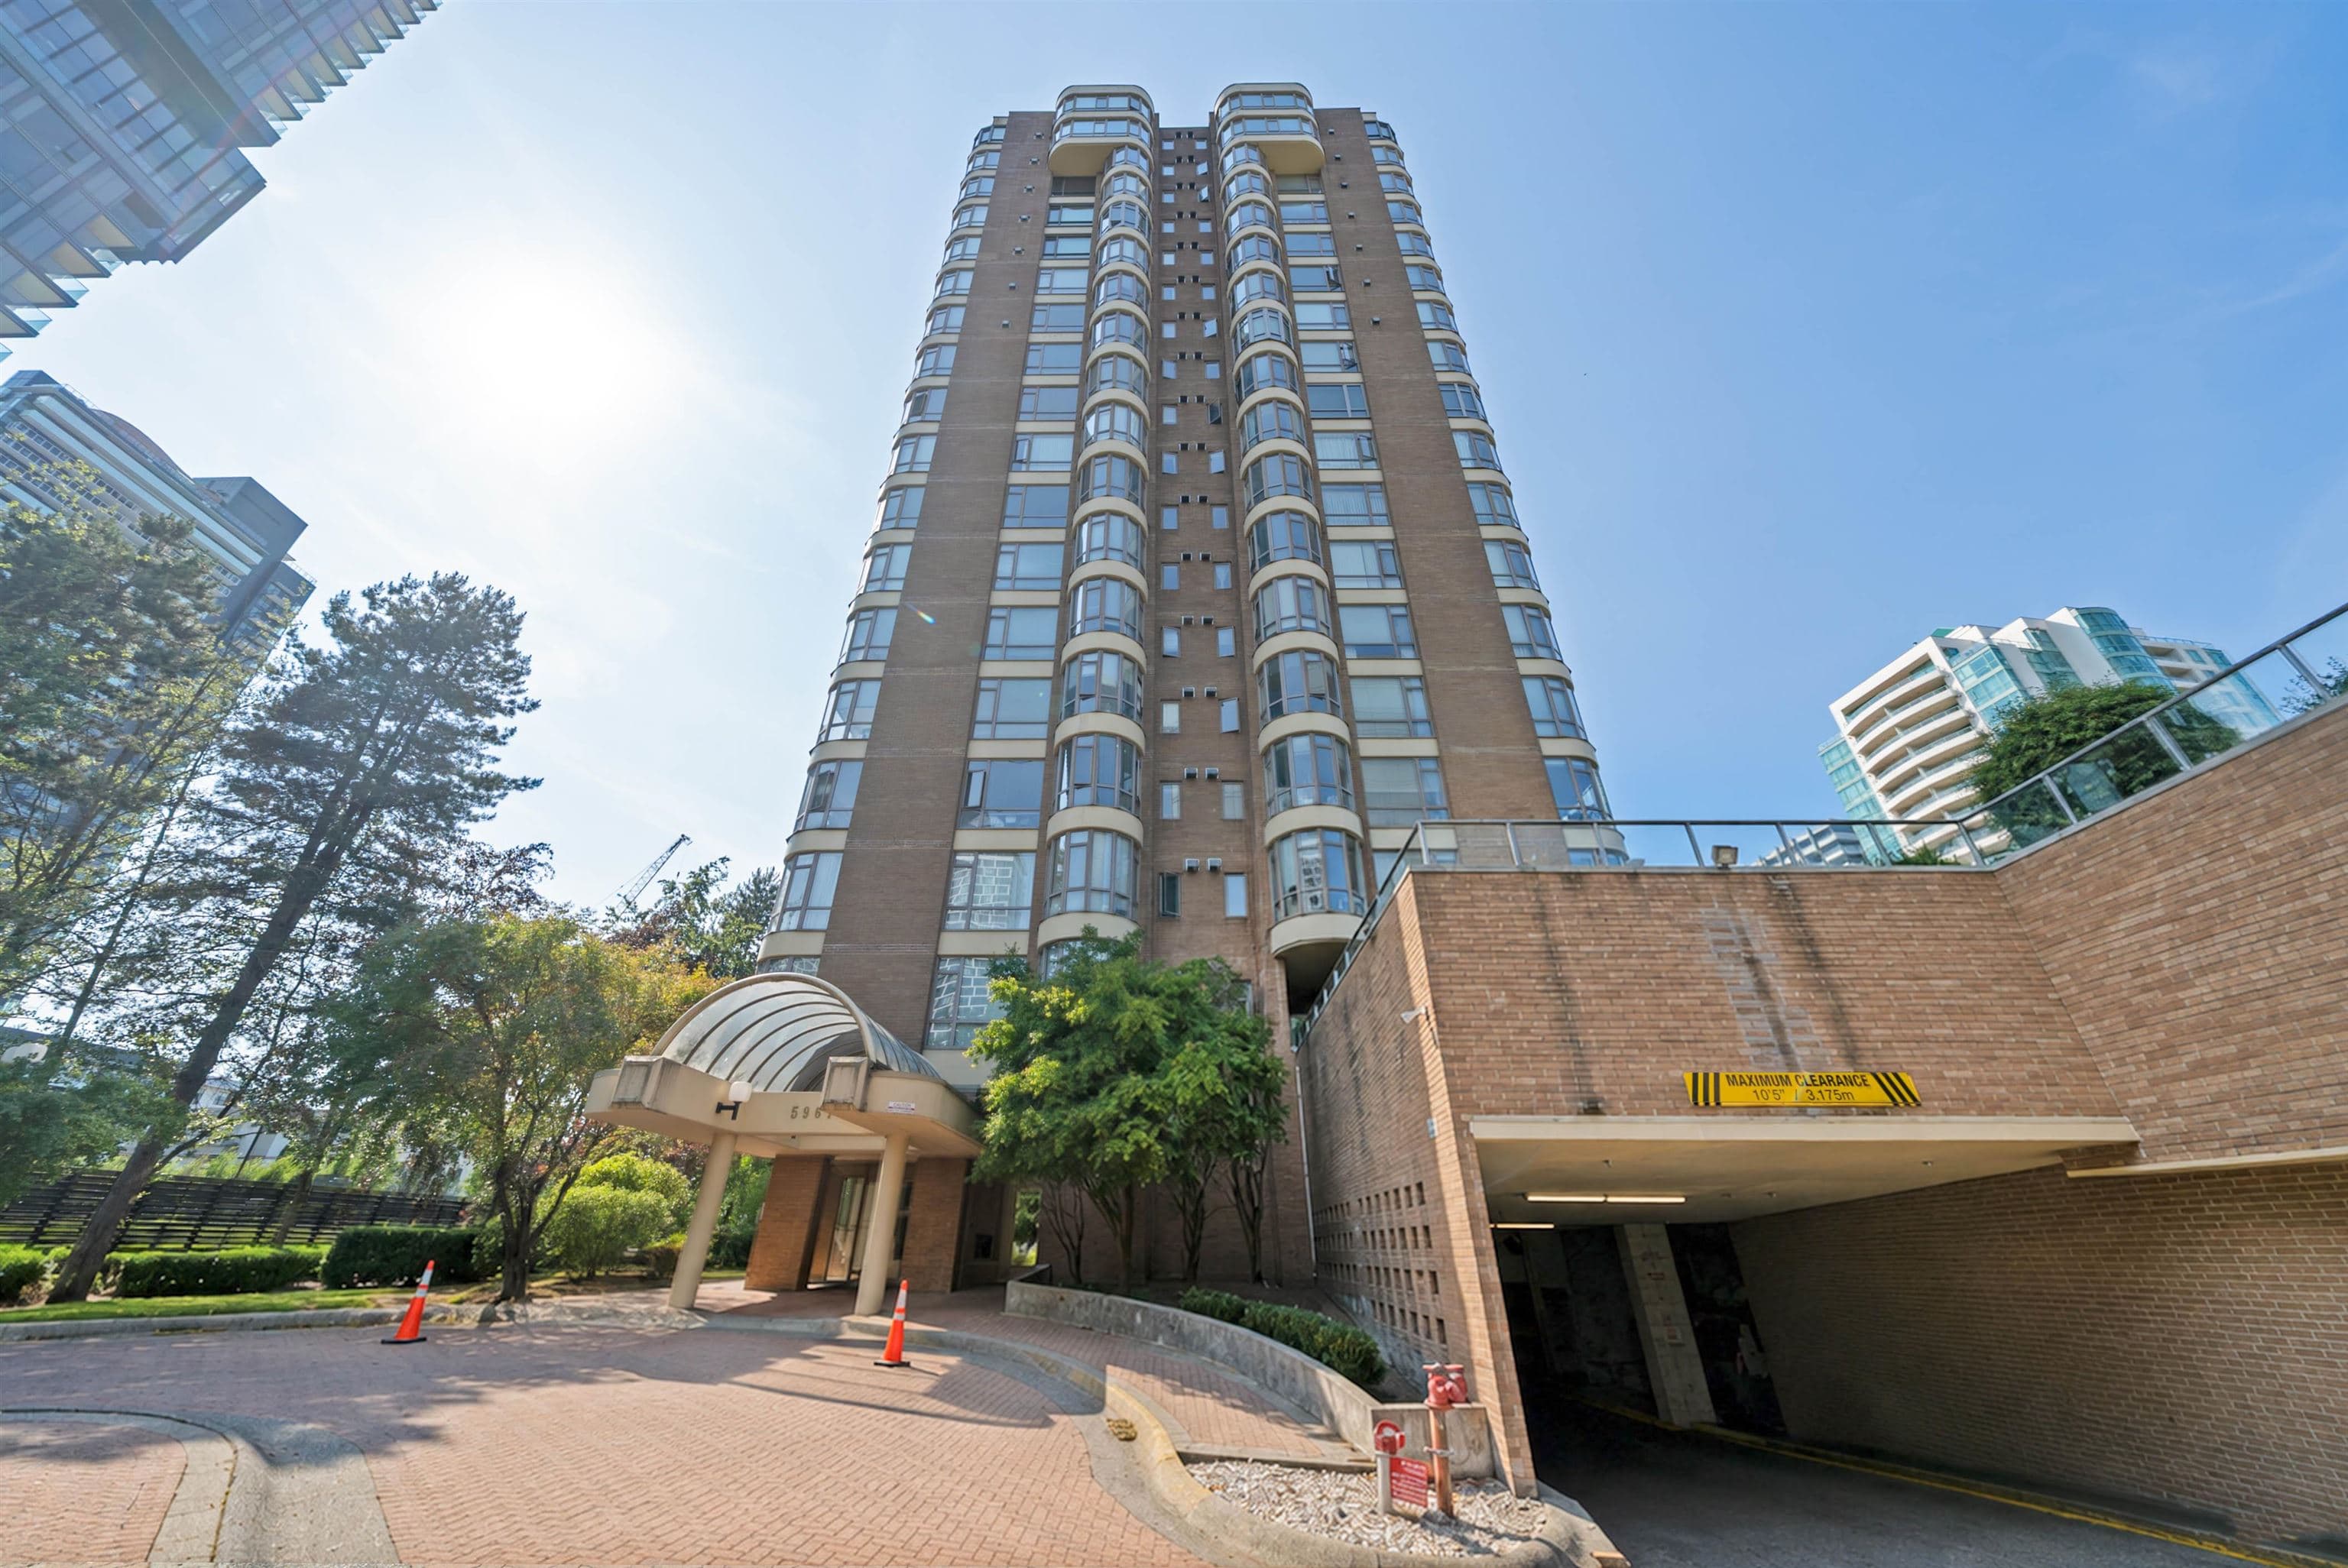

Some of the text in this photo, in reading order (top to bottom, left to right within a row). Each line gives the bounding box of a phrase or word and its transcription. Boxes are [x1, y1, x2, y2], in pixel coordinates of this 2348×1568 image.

[1725, 1074, 1870, 1087] MAXIMUM CLEARANCE
[1805, 1089, 1855, 1100] 3.175m
